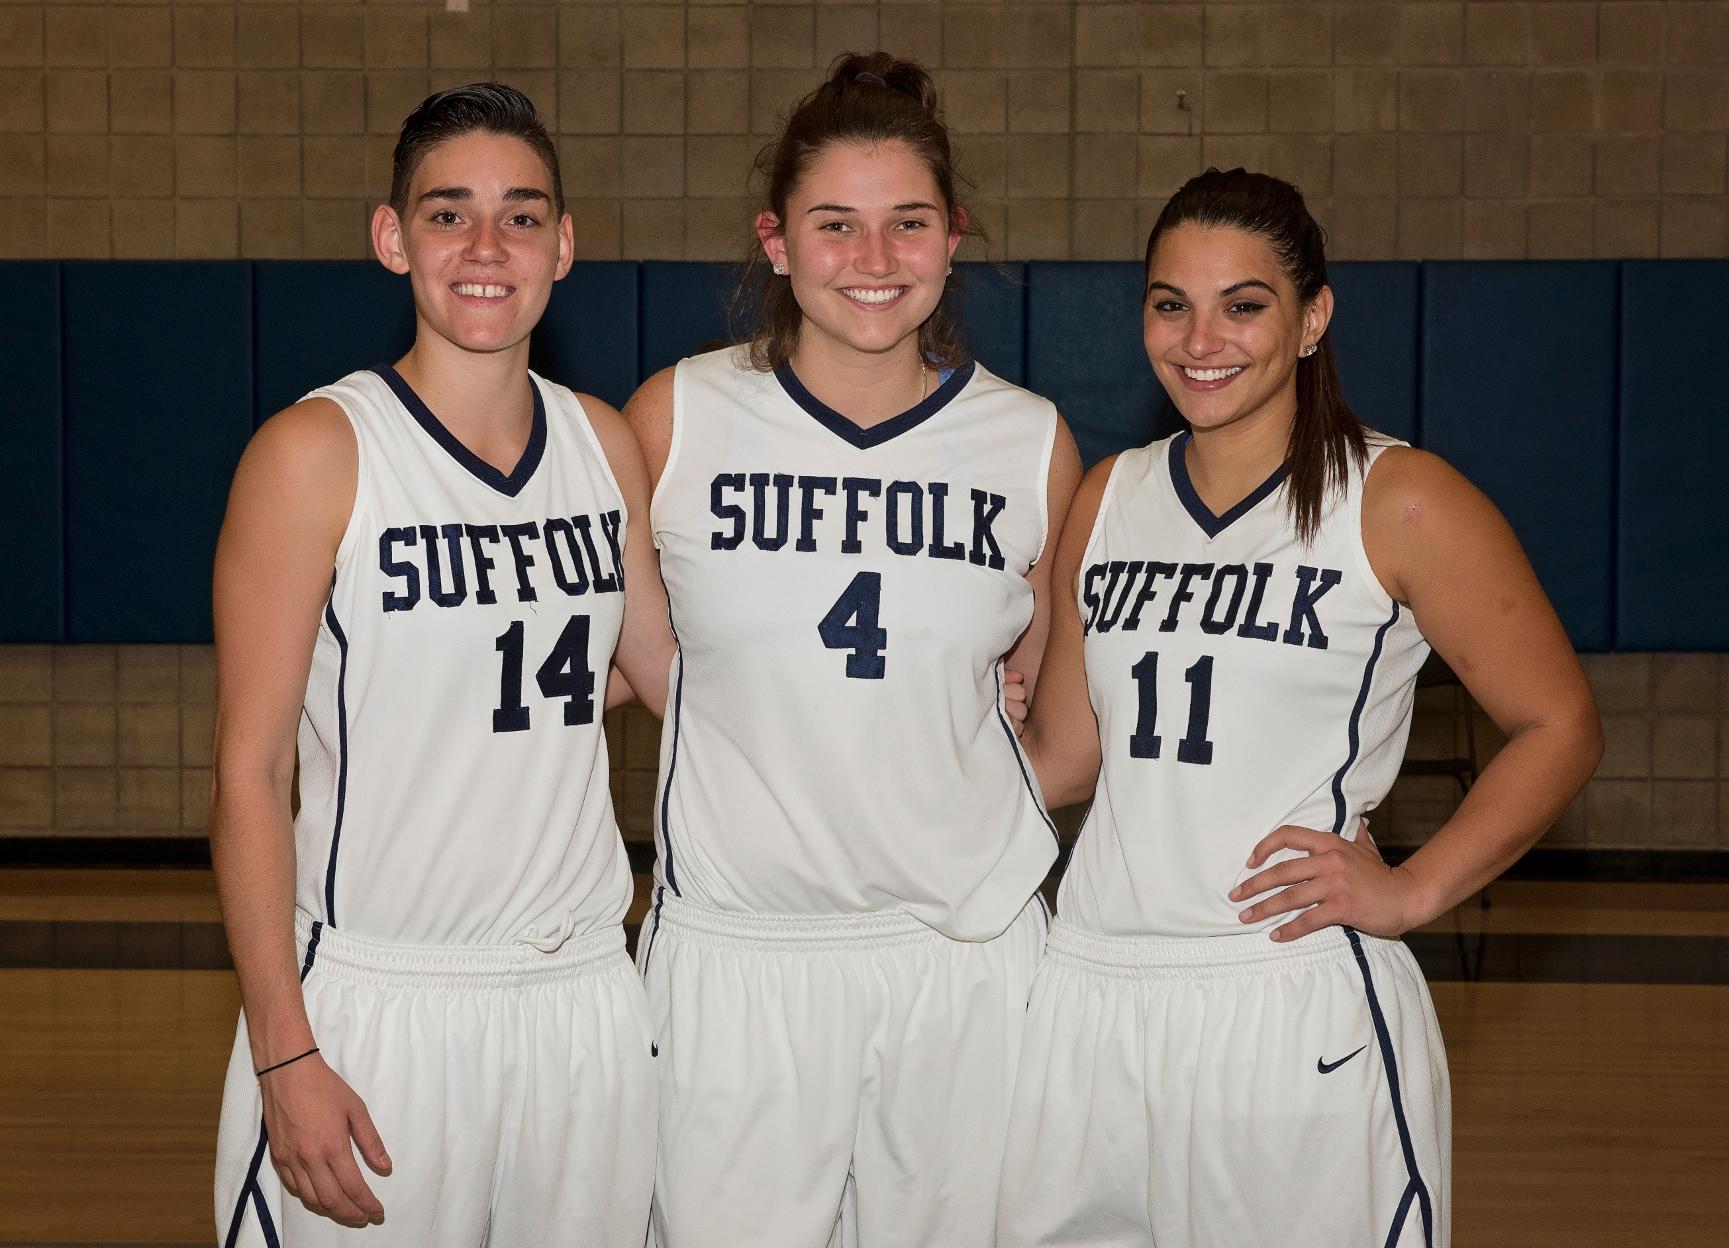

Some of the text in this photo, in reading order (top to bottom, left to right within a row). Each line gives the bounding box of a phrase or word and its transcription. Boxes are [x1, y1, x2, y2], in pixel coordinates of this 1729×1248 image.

[710, 472, 1006, 571] SUFFOLK
[817, 571, 887, 679] 4
[1083, 561, 1342, 650] SUFFOLK
[493, 615, 595, 733] 14
[1130, 651, 1214, 765] 11
